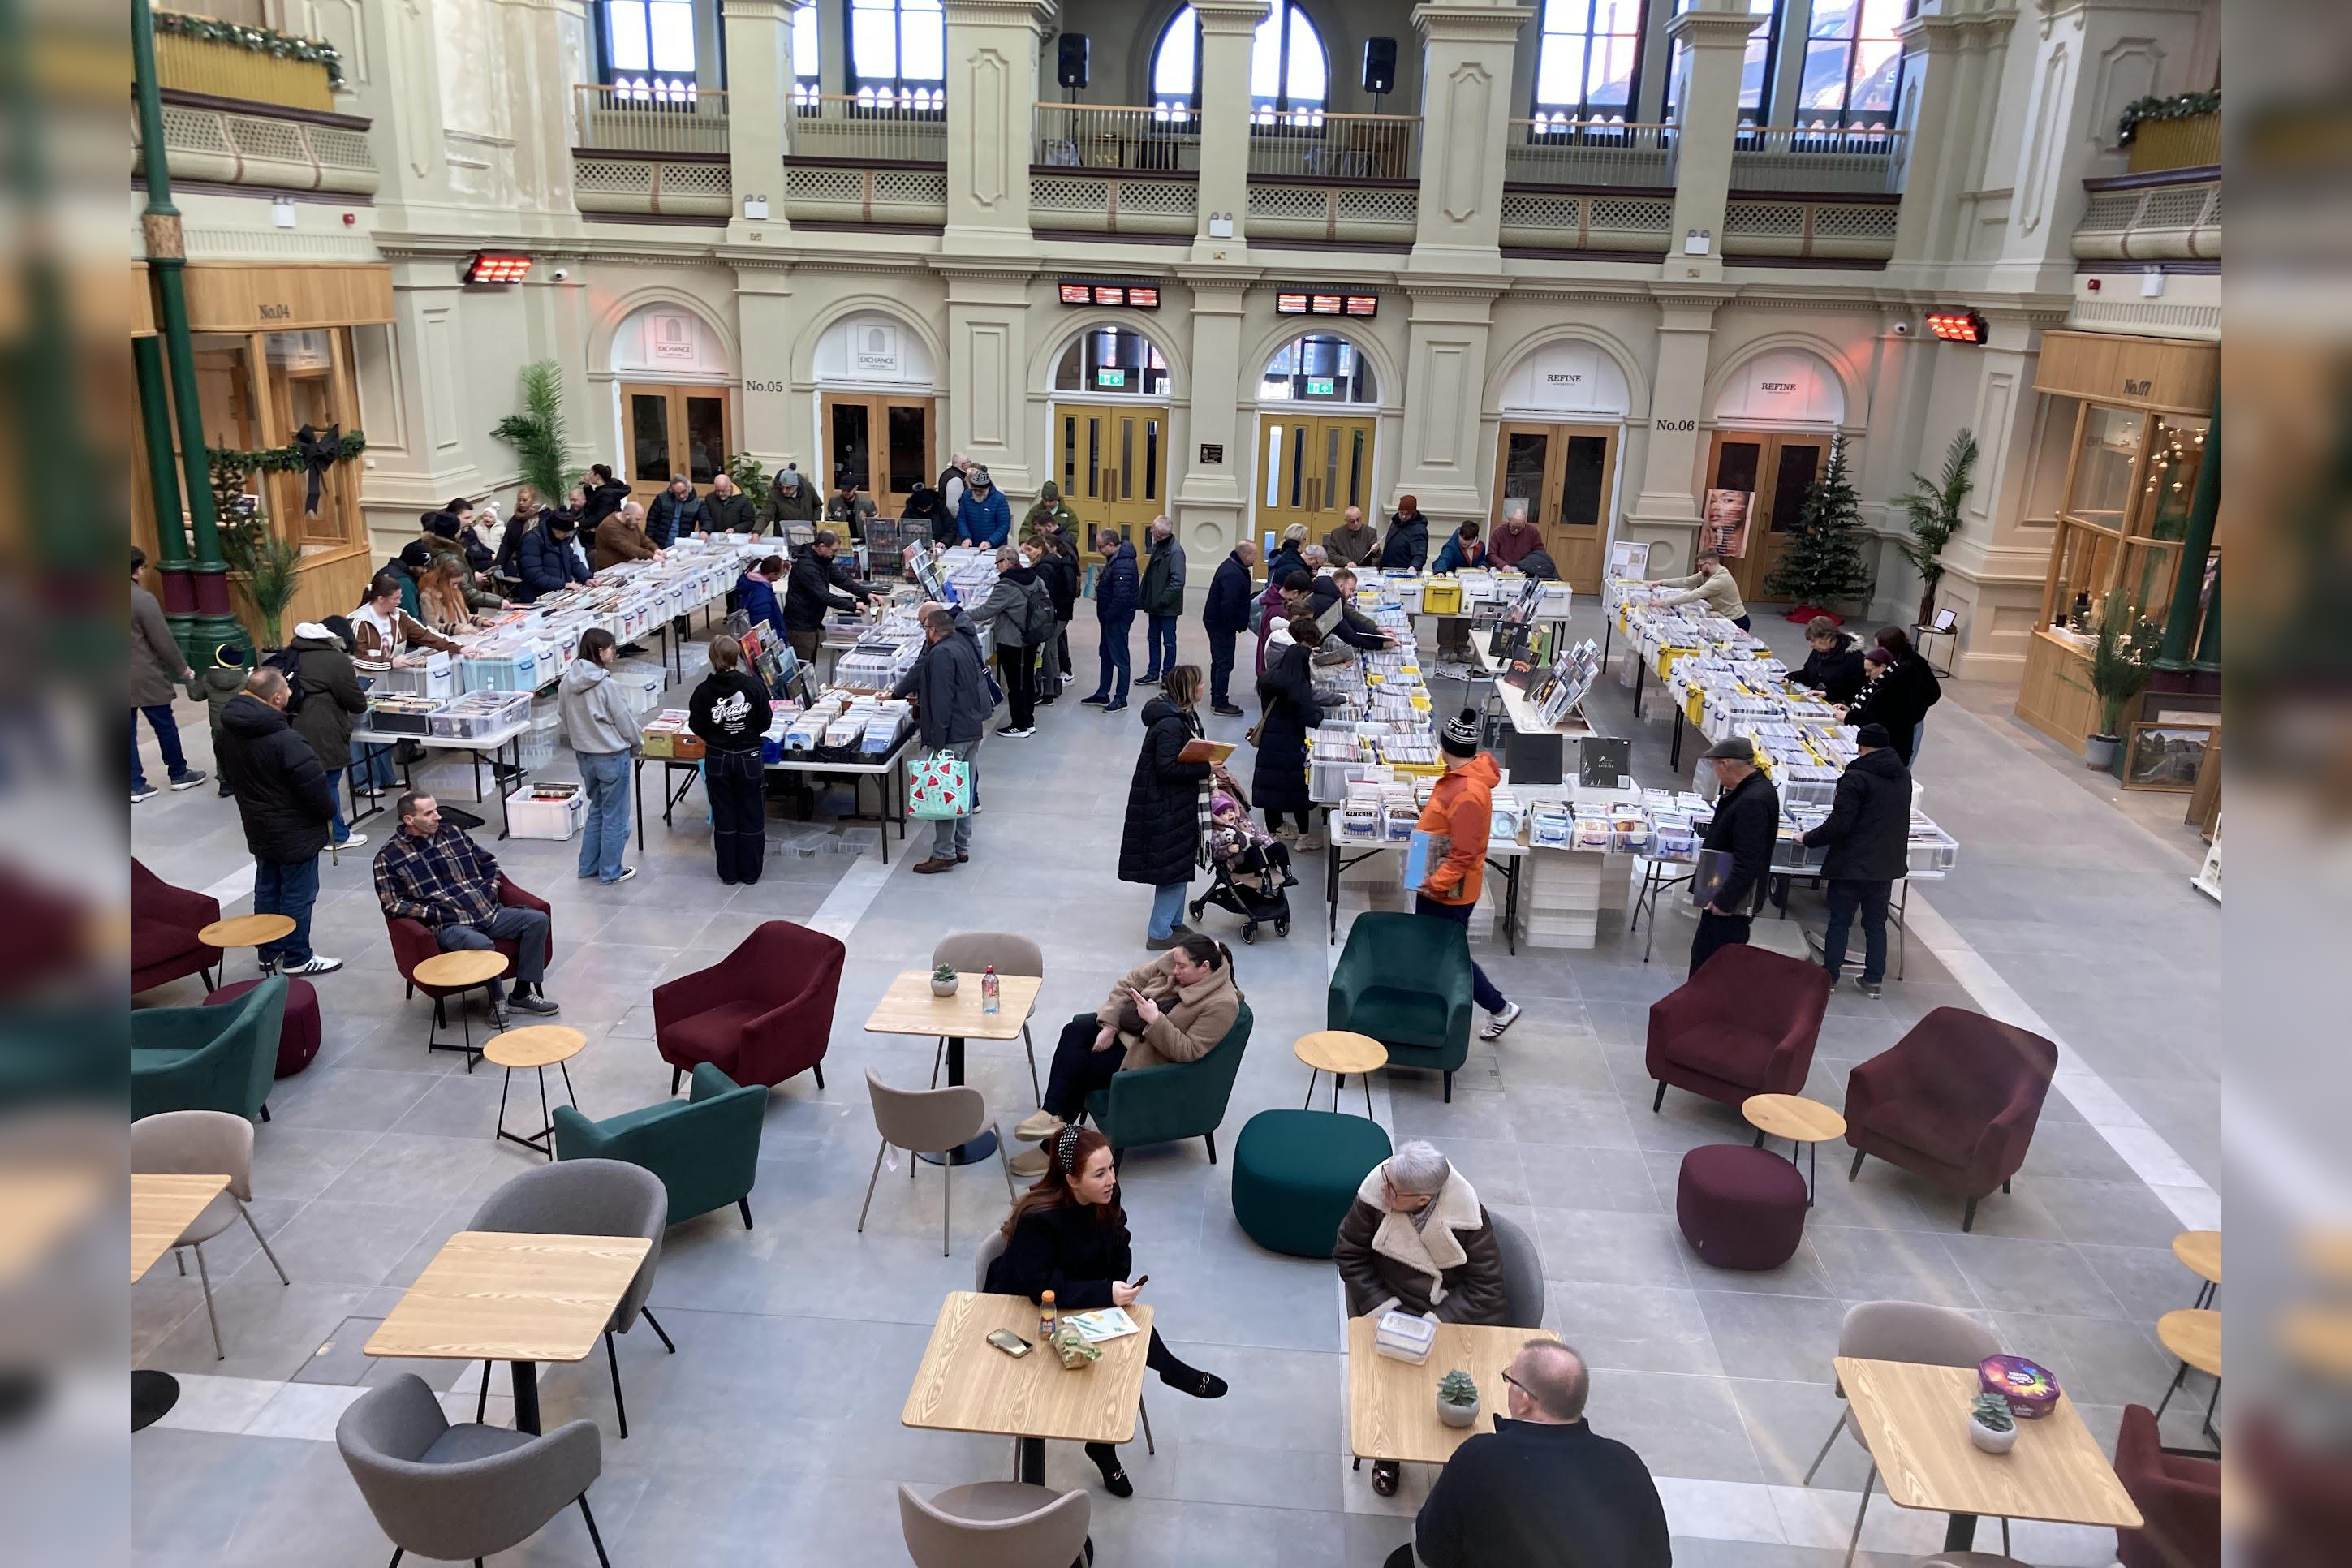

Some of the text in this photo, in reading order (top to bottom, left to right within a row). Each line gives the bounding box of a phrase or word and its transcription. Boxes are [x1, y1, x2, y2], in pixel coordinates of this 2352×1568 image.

[258, 304, 290, 319] No.04
[859, 356, 894, 364] EXCHANGE
[1547, 374, 1582, 382] REFINE
[746, 380, 782, 392] No.05
[1760, 382, 1797, 391] REFINE
[1656, 419, 1695, 431] No.06
[710, 702, 752, 724] Grease
